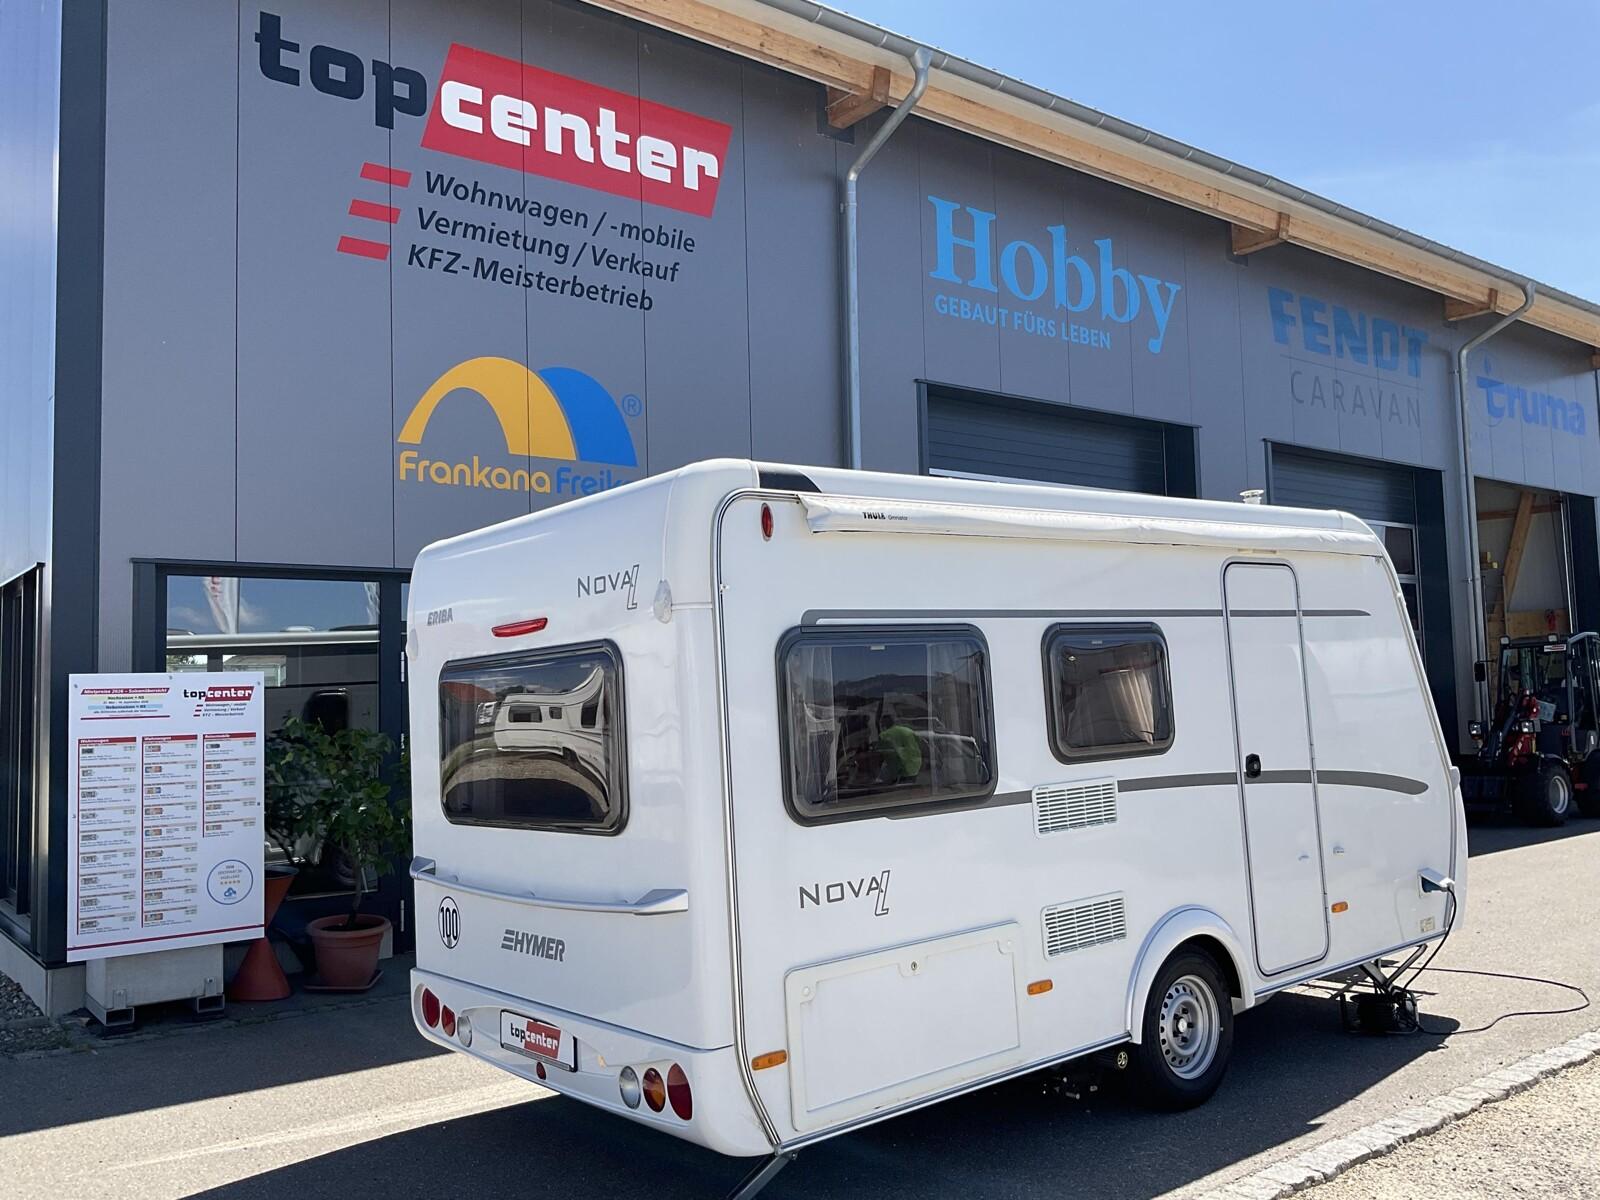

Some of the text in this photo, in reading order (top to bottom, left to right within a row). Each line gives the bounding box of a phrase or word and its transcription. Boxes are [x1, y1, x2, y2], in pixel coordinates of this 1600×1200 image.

[425, 170, 589, 229] Wohnwagen
[417, 207, 570, 265] Vermietung
[591, 245, 680, 282] Verkauf
[407, 243, 654, 312] KFZ-Meisterbetrieb
[928, 195, 1181, 354] Hobby
[934, 294, 1111, 349] GEBAUT FÜRS LEBEN
[1267, 286, 1429, 379] FENDT
[1289, 370, 1421, 428] CARAVAN
[1476, 376, 1585, 436] truma
[399, 450, 637, 496] Frankana Freik
[862, 511, 886, 520] THULE
[427, 607, 454, 626] ERIBA
[440, 906, 459, 940] 100
